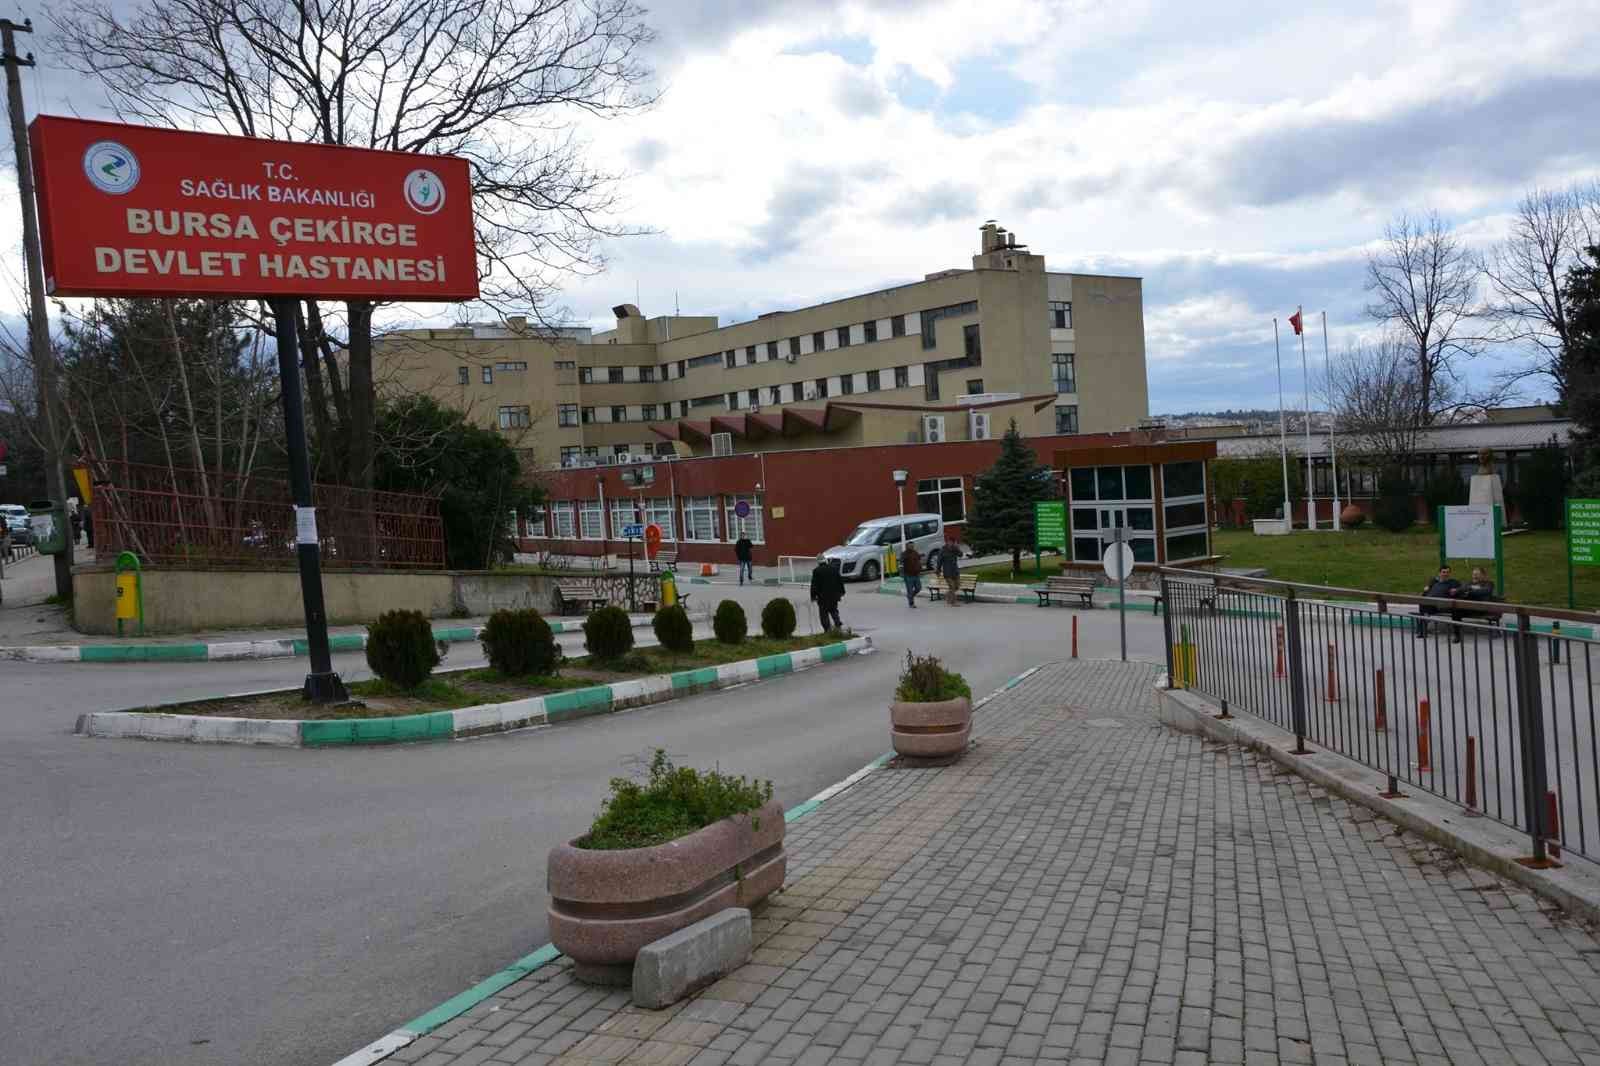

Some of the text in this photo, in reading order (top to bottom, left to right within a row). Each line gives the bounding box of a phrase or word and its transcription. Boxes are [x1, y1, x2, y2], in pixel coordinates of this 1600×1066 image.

[262, 162, 299, 180] T.C.
[180, 178, 376, 209] SAĞLIK BAKANLIĞI
[126, 208, 418, 247] BURSA ÇEKİRGE
[94, 246, 446, 283] DEVLET HASTANESİ
